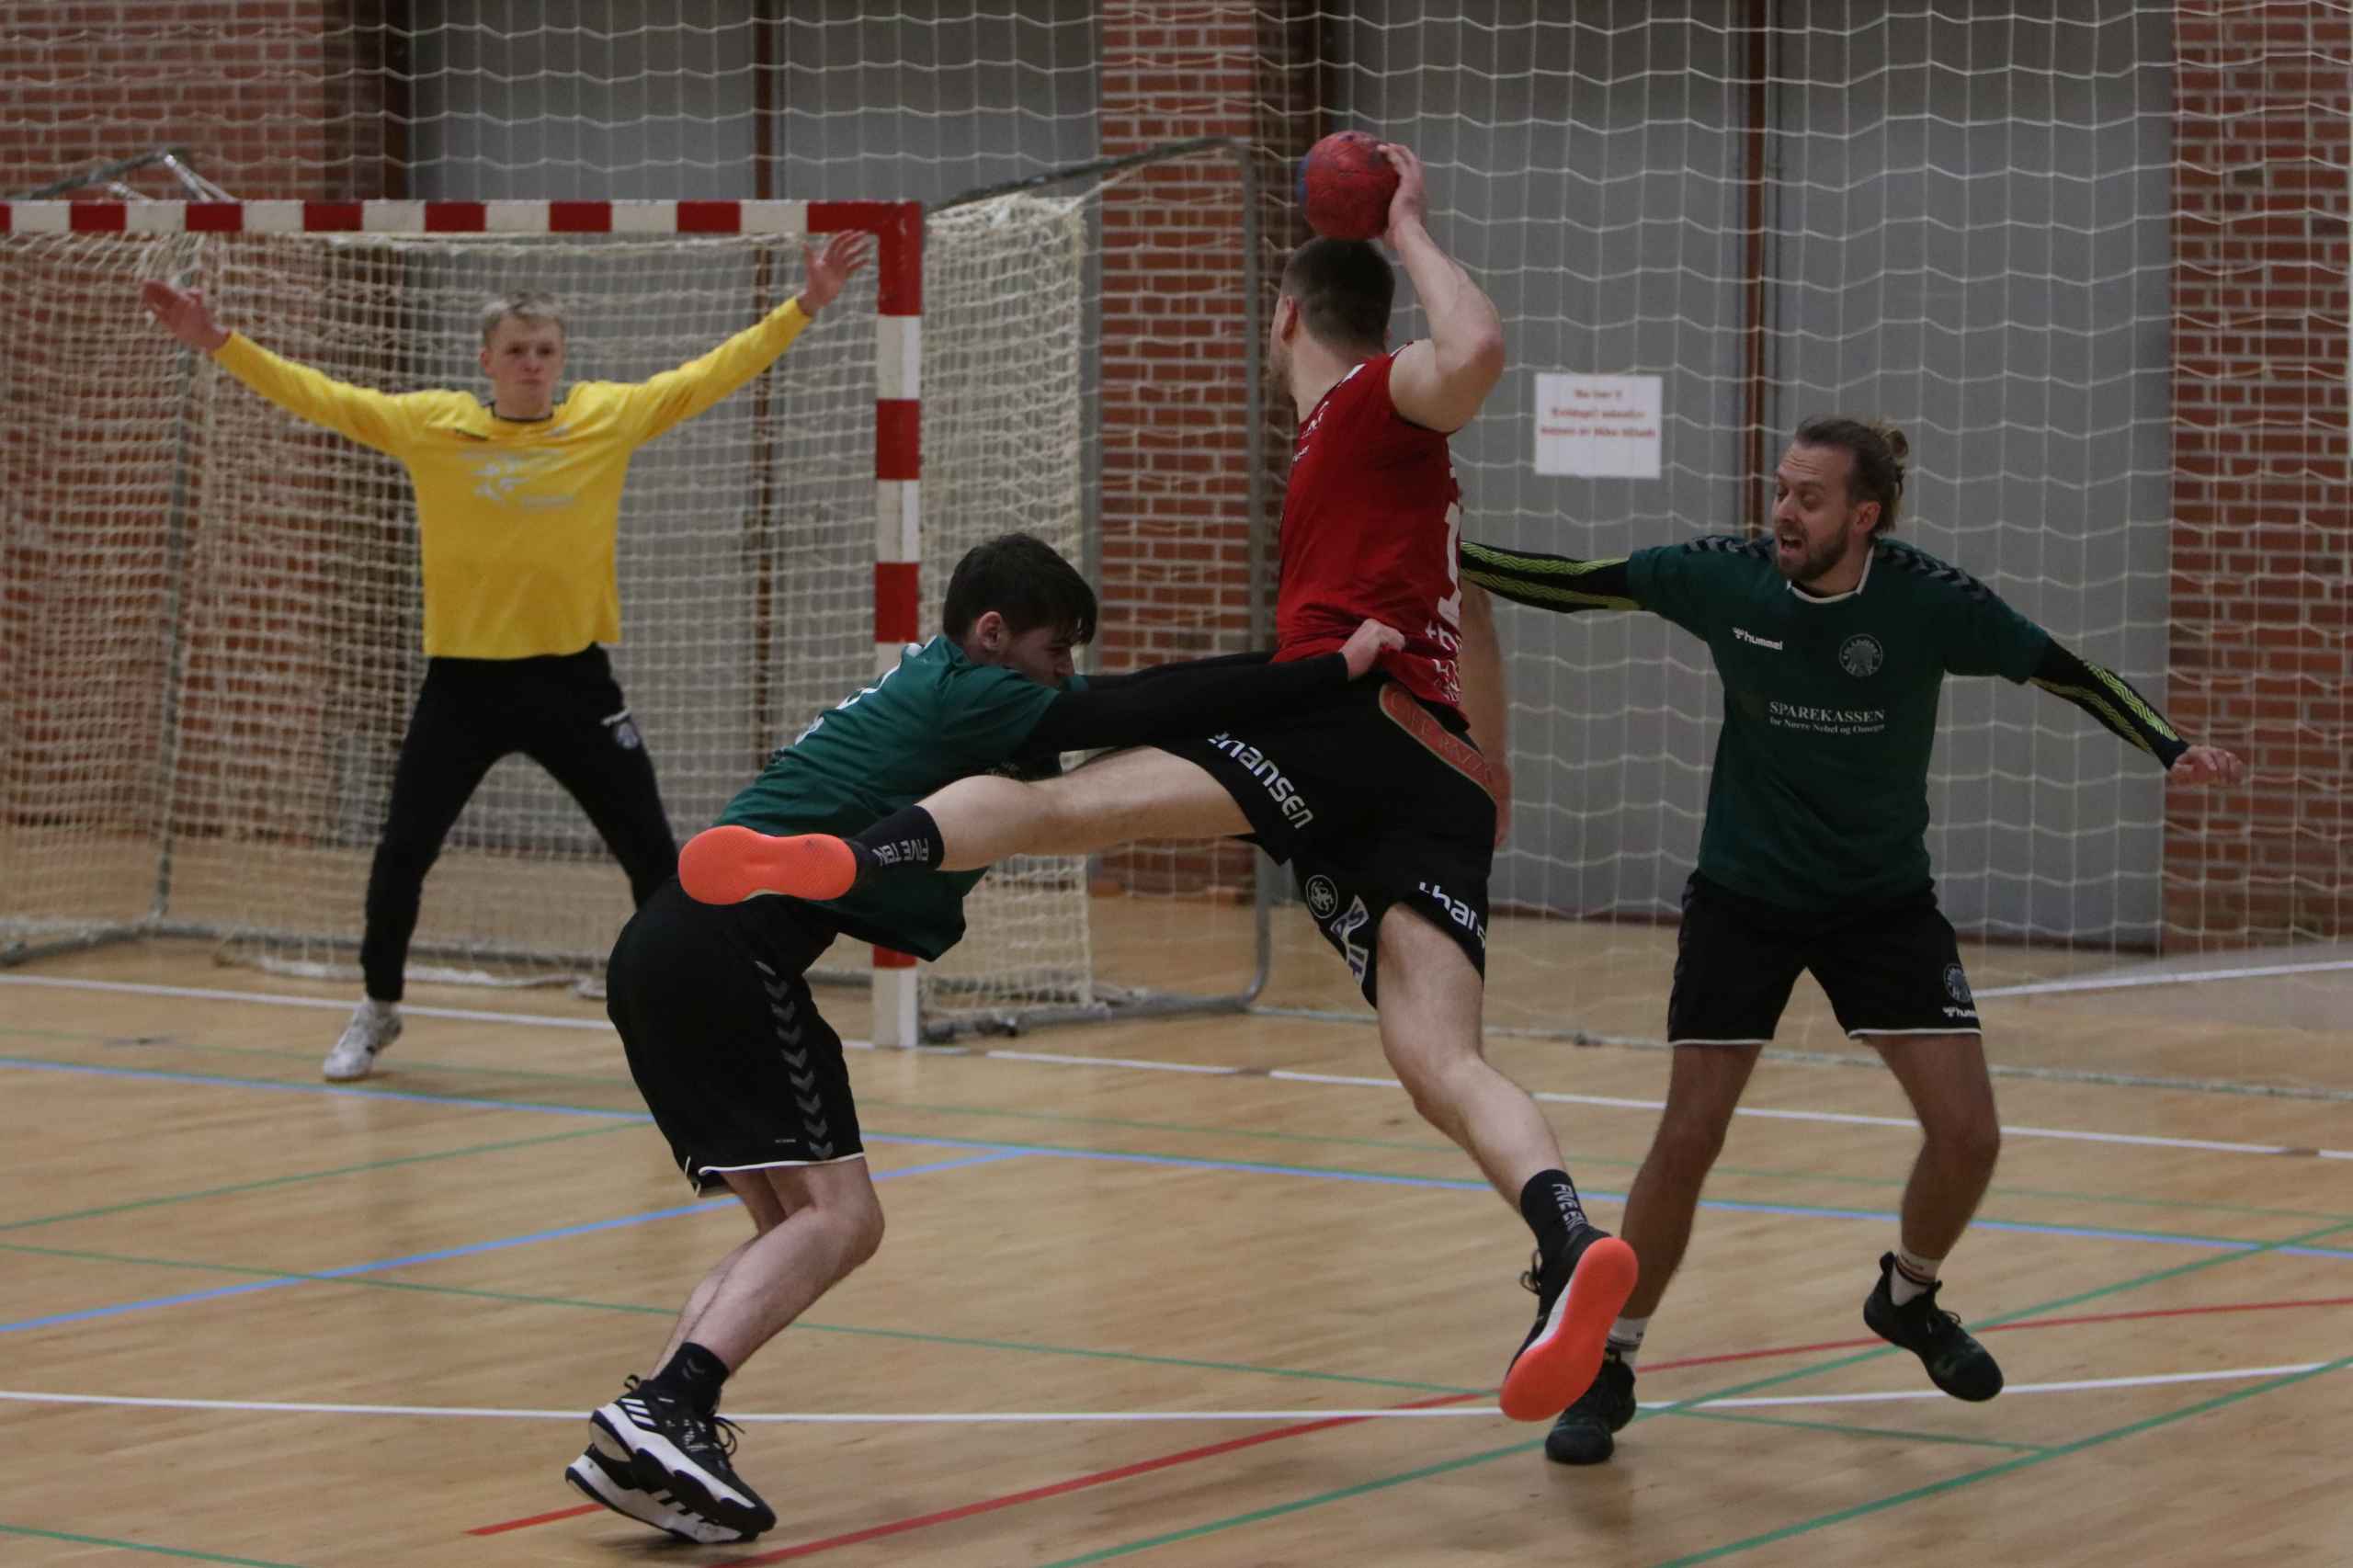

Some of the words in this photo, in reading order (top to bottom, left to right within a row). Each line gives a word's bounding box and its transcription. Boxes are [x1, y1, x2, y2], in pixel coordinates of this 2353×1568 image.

[1769, 700, 1885, 723] SPAREKASSEN
[1839, 726, 1851, 735] og
[900, 837, 930, 862] FIVE
[1552, 1184, 1578, 1210] FIVE
